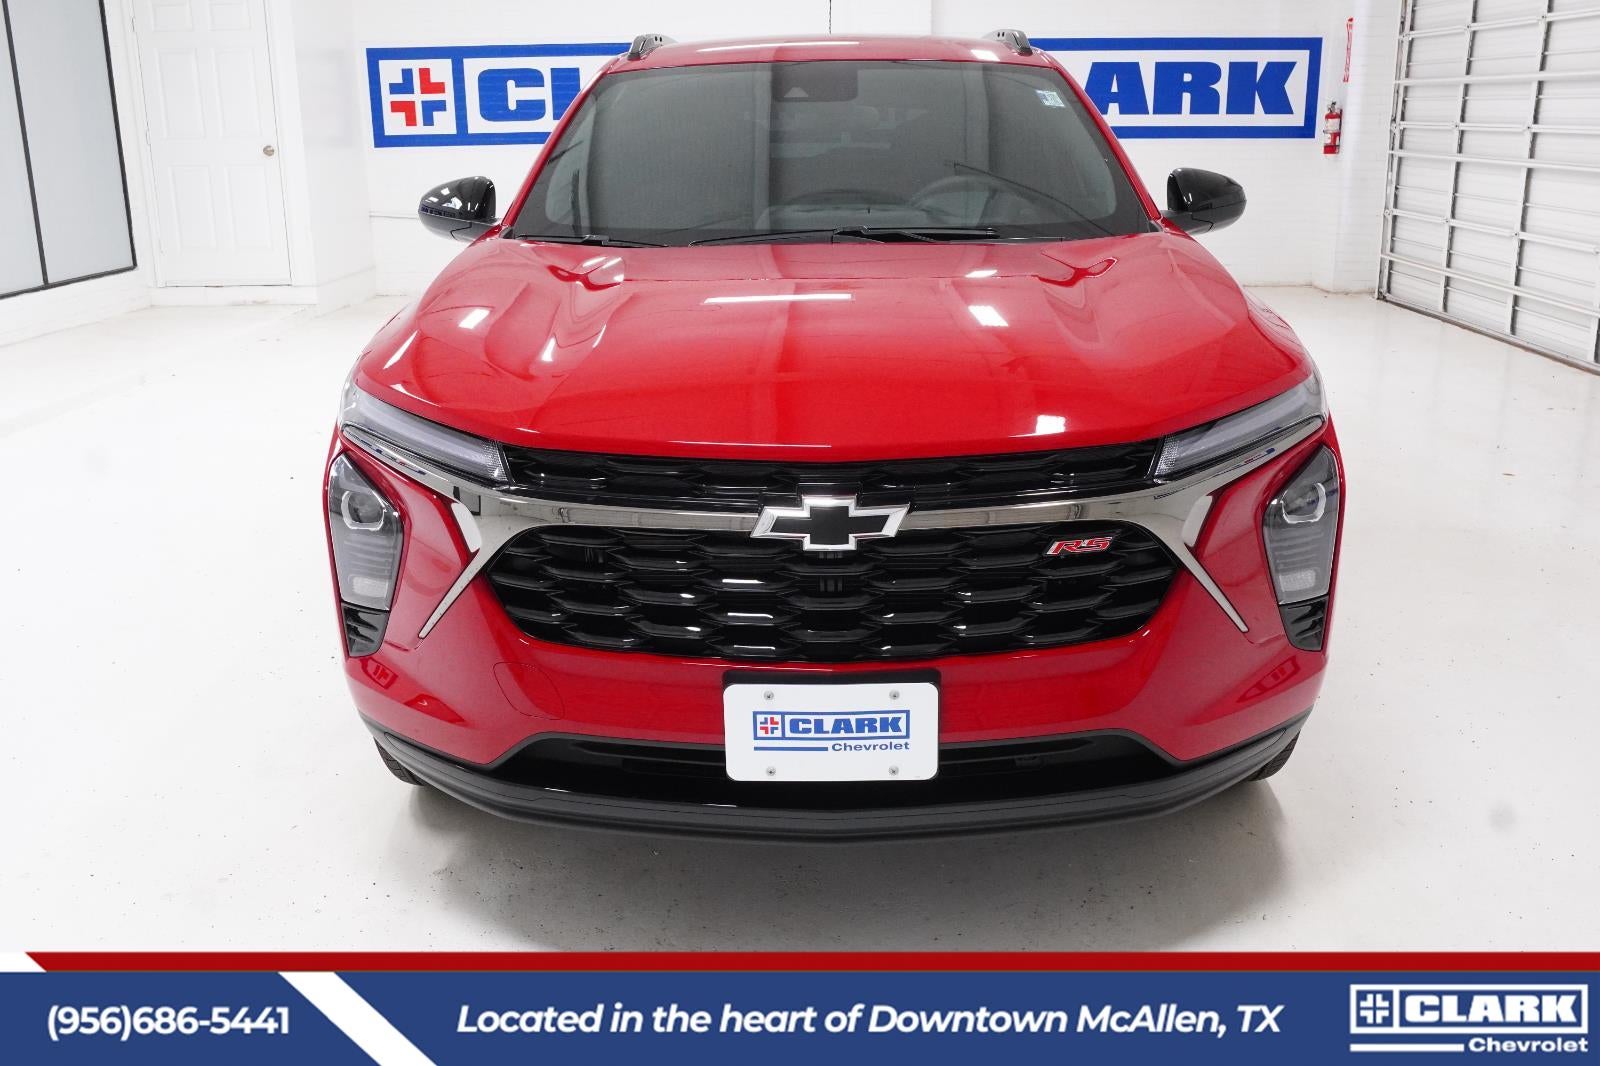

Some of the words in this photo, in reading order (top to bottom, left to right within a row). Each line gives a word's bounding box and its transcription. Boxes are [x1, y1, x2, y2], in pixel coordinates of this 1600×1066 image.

[1084, 61, 1297, 115] ARK
[1046, 536, 1113, 555] RS
[789, 716, 904, 735] CLARK
[831, 739, 910, 752] Chevrolet
